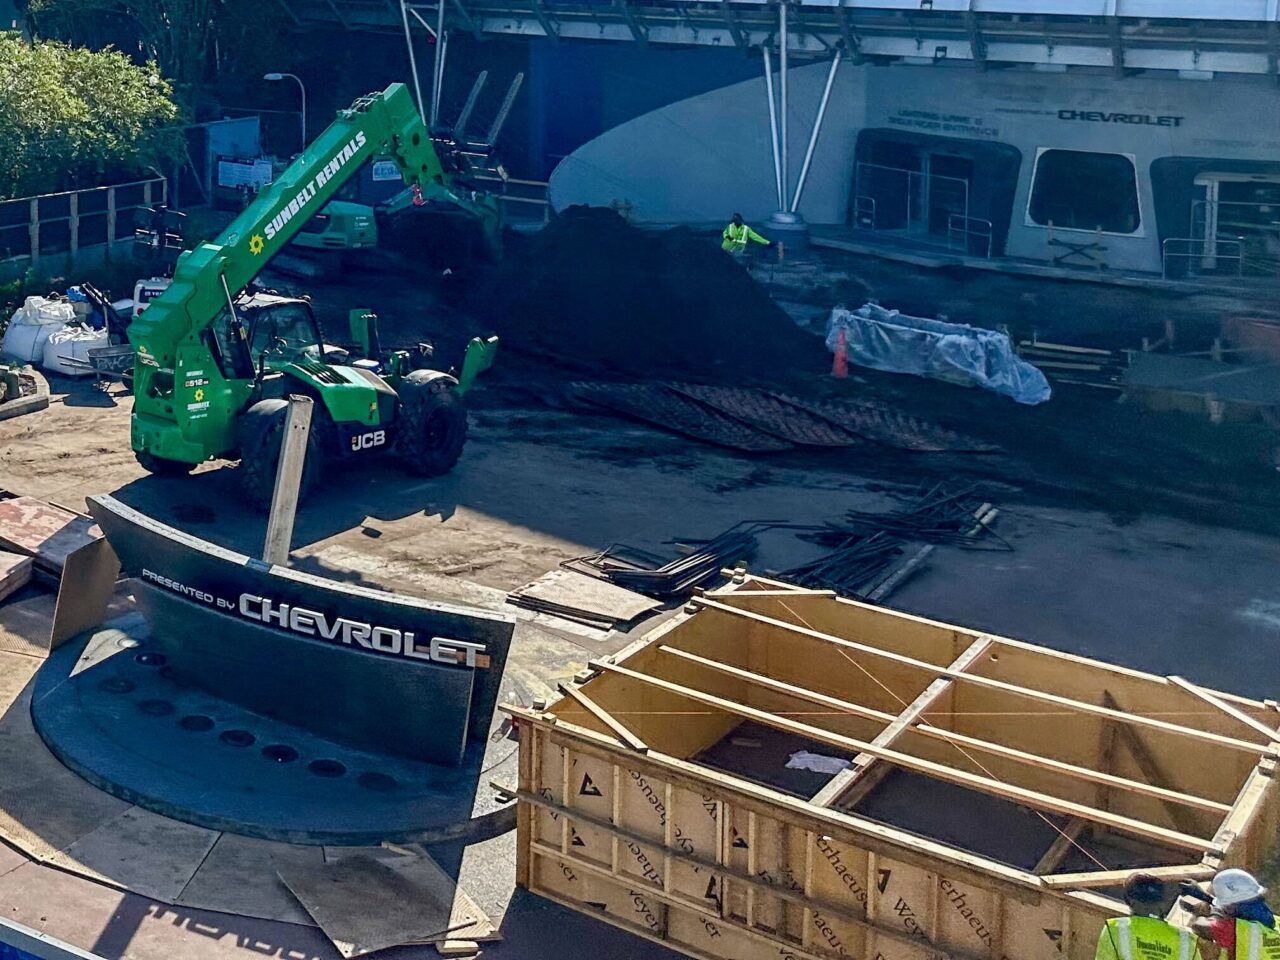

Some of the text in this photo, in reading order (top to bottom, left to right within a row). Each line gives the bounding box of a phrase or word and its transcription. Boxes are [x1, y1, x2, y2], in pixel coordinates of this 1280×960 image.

[1057, 109, 1185, 127] CHEVROLET
[264, 180, 317, 240] SUNBELT
[315, 130, 367, 189] RENTALS
[352, 430, 385, 451] JCB
[142, 568, 486, 669] PRESENTED BY CHEVROLET
